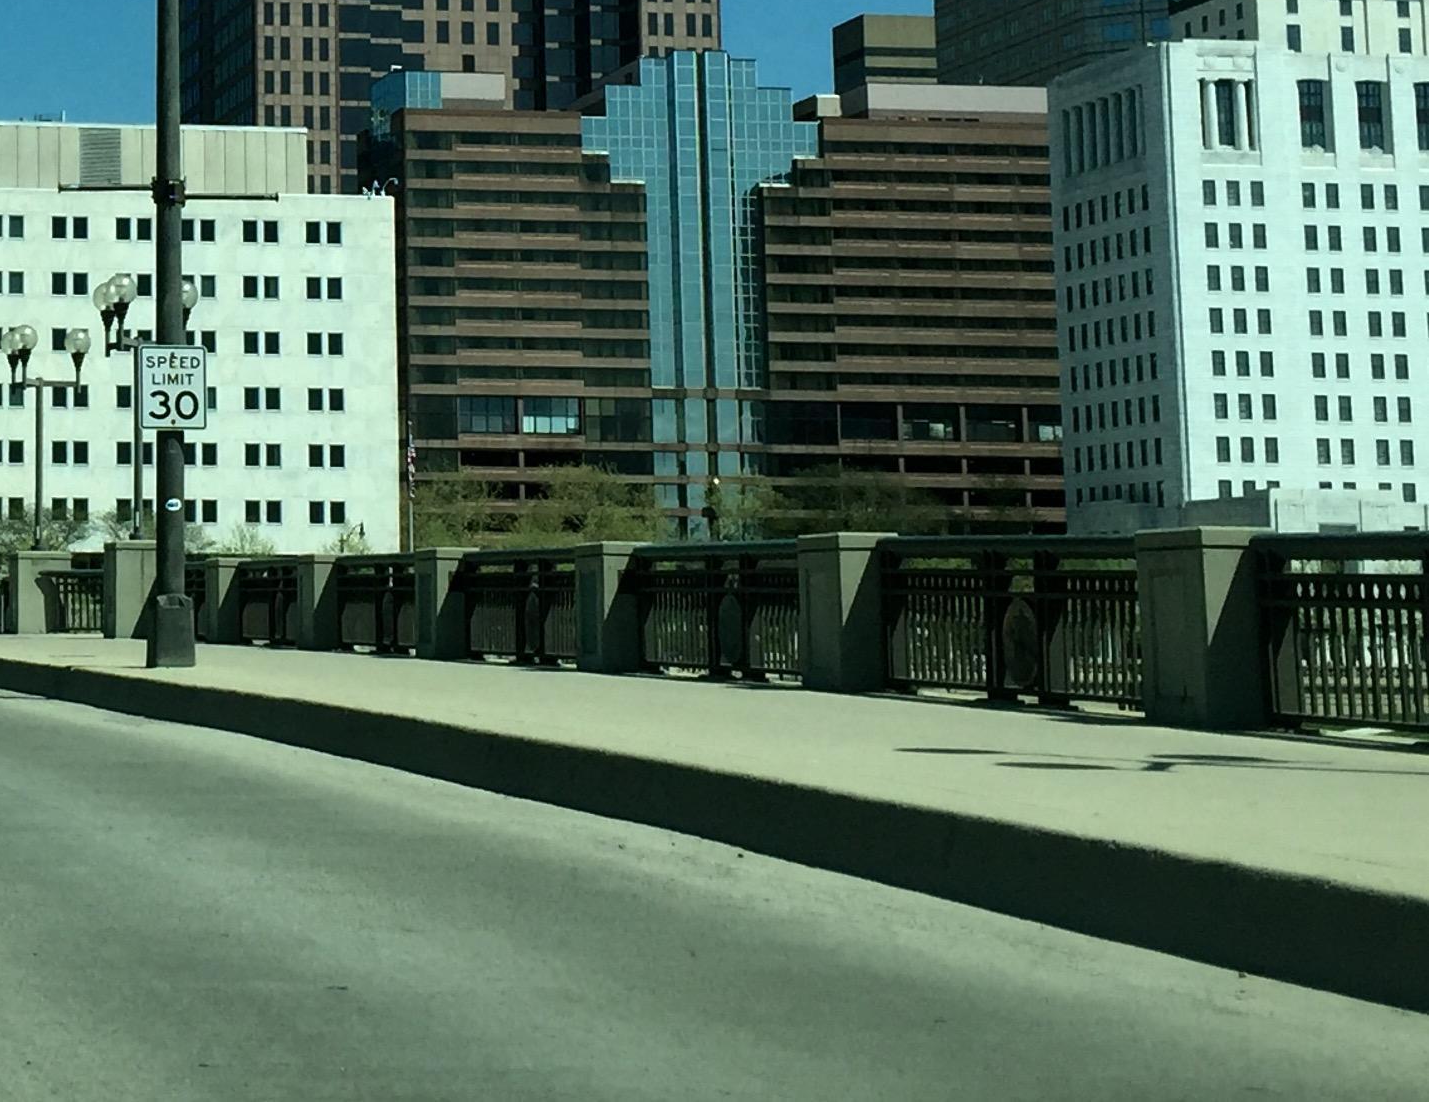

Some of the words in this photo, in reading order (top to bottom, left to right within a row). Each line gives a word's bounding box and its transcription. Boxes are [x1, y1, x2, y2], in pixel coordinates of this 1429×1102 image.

[145, 355, 201, 369] SPEED
[152, 373, 194, 385] LIMIT
[148, 390, 199, 420] 30
